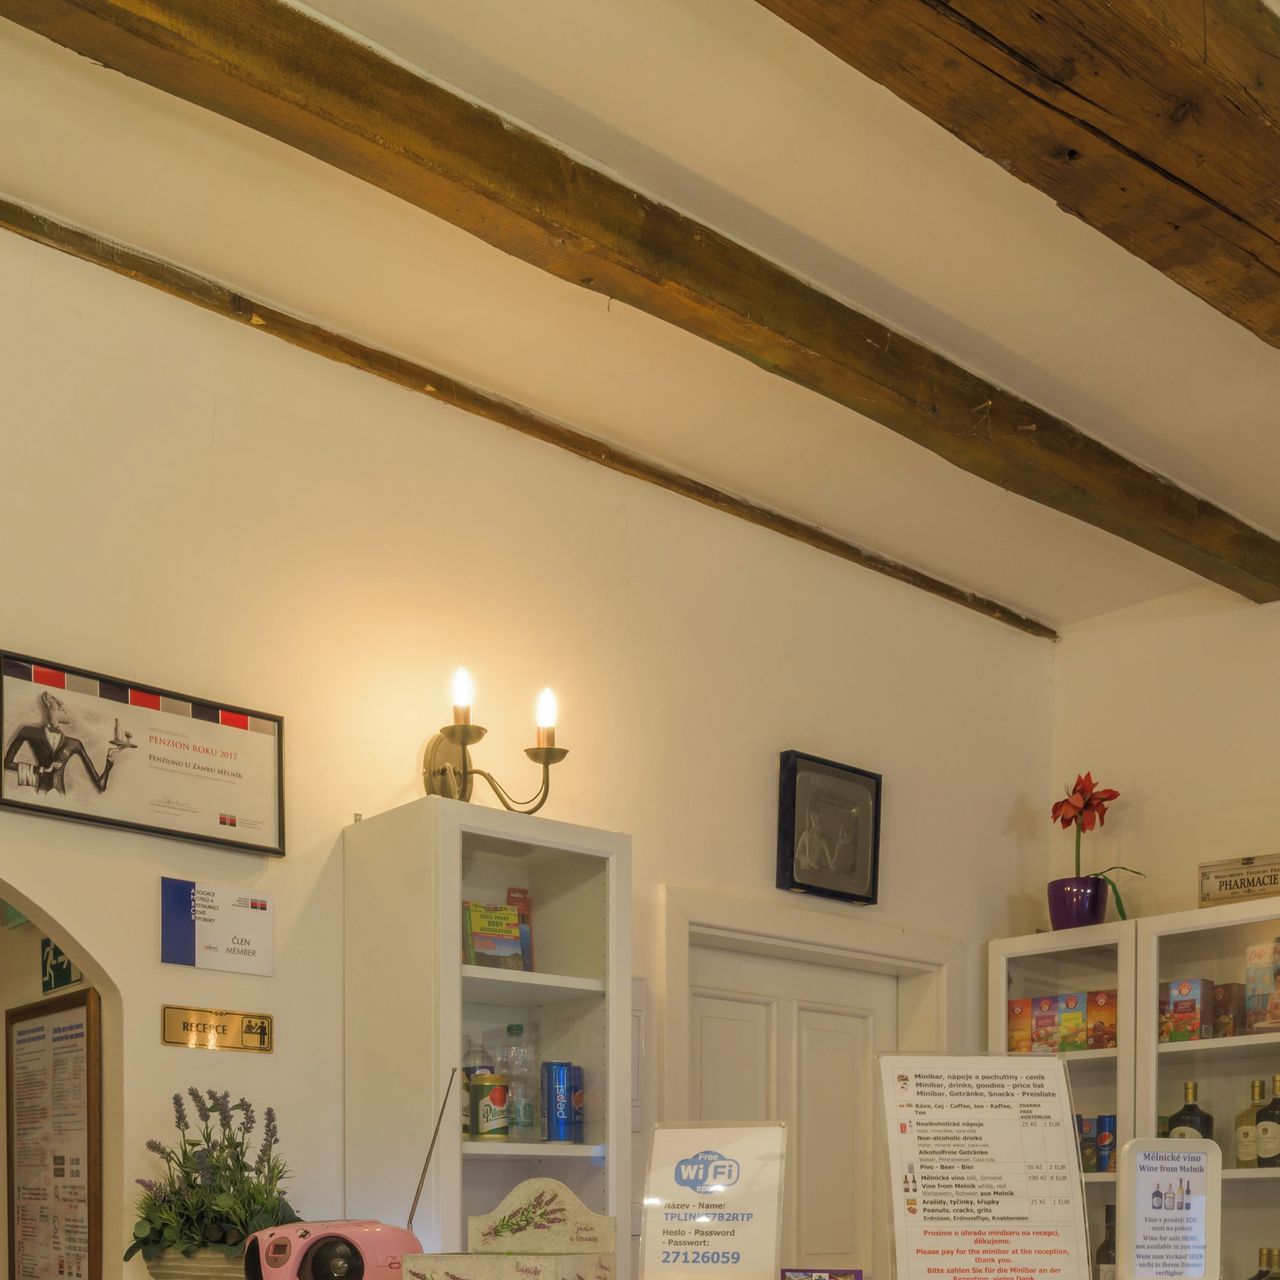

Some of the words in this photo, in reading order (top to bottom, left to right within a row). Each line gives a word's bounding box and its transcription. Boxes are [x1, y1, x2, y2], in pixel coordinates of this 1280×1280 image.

[149, 735, 189, 751] PENZION
[192, 744, 217, 757] ROKU
[220, 750, 238, 760] 2017
[1219, 874, 1279, 891] PHARMACIE
[232, 936, 250, 945] ČLEN
[226, 947, 256, 956] MEMBER
[947, 1074, 973, 1082] nápoje
[981, 1074, 1019, 1082] pochutiny
[976, 1082, 1005, 1090] goodies
[1012, 1082, 1031, 1090] price
[556, 1085, 567, 1119] pepsi
[962, 1121, 984, 1129] nápoje
[1143, 1152, 1181, 1162] Mělnické
[1183, 1153, 1201, 1162] víno
[1139, 1165, 1159, 1173] Wine
[1160, 1165, 1178, 1173] from
[1180, 1165, 1204, 1173] Melnik
[664, 1201, 690, 1210] Název
[698, 1202, 726, 1210] Name:
[1032, 1230, 1060, 1238] recepci,
[662, 1251, 740, 1264] 27126059
